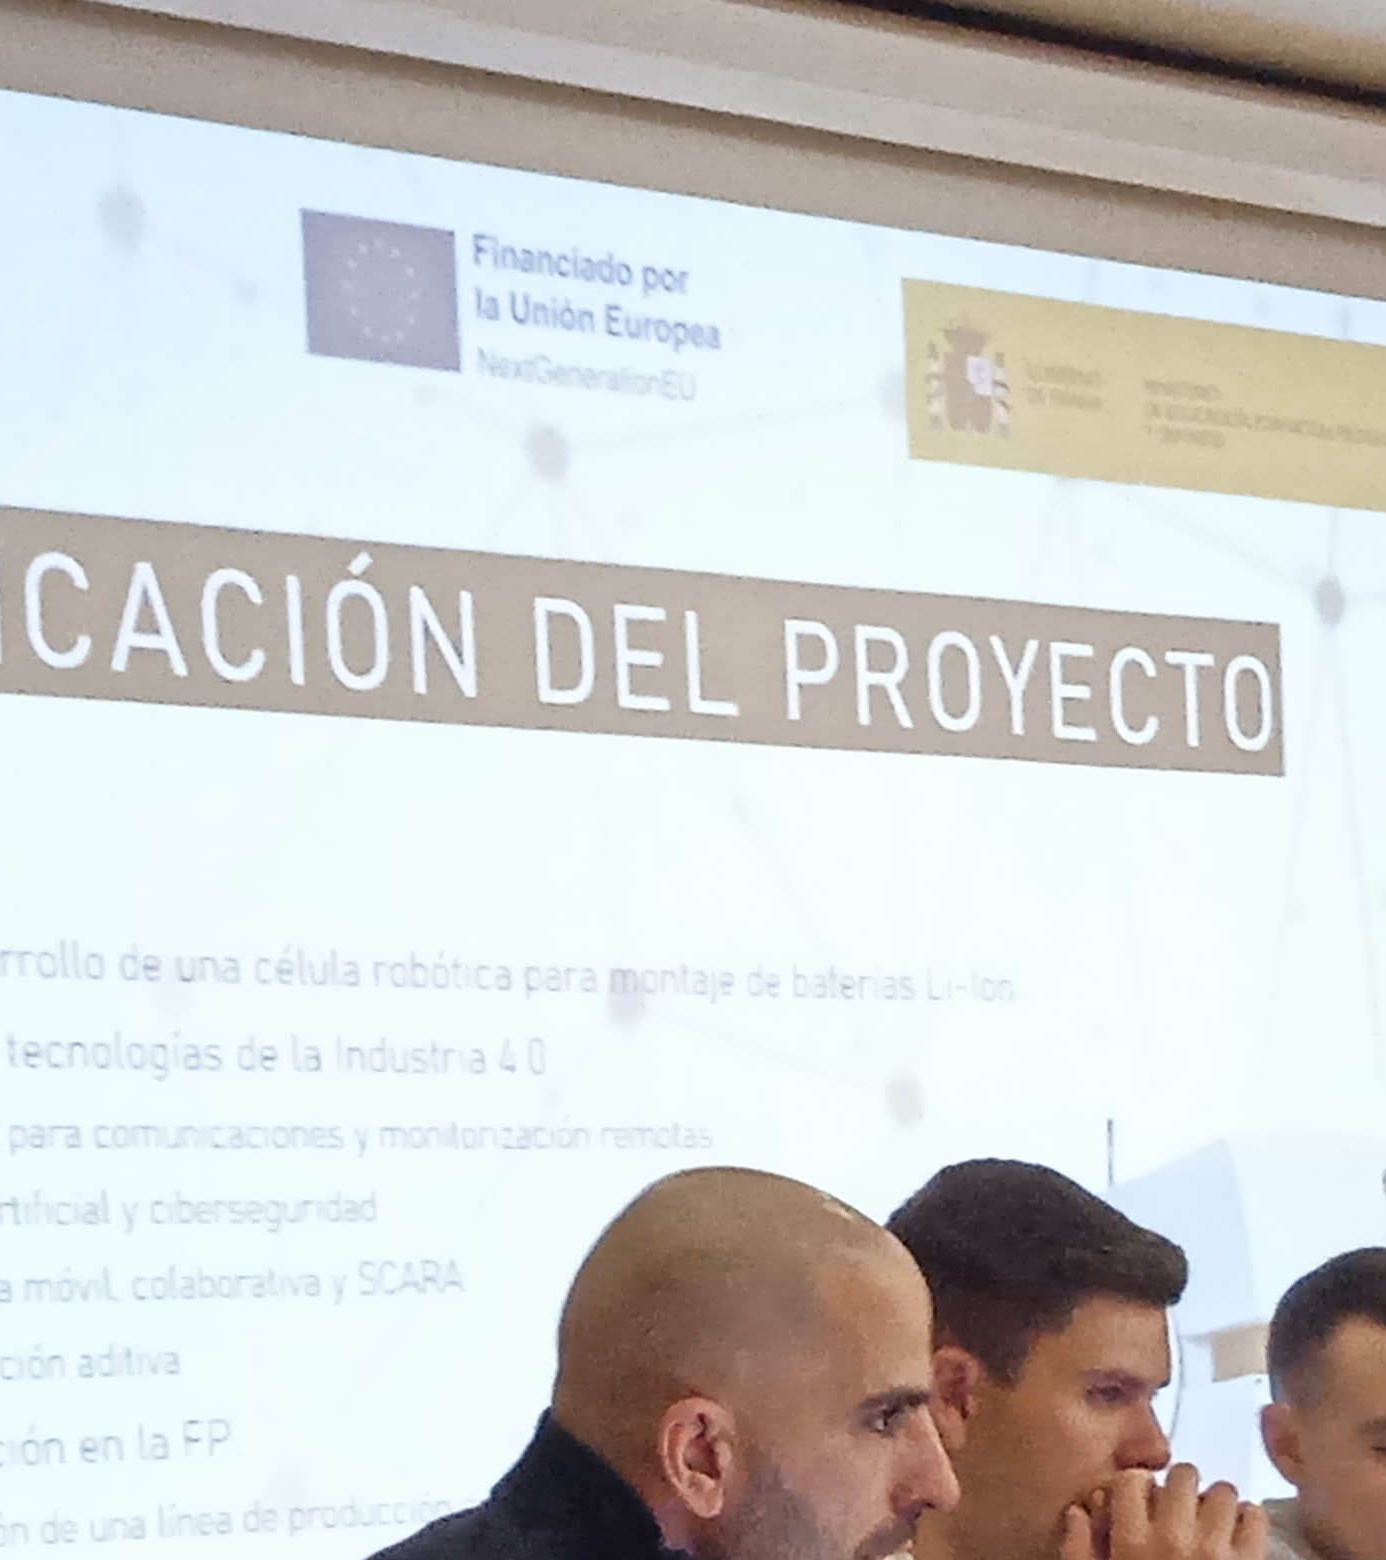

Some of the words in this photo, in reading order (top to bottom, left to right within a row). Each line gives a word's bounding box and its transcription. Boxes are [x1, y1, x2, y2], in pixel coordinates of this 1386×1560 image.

[472, 233, 633, 286] Financiado
[642, 265, 689, 299] por
[473, 286, 499, 321] la
[509, 289, 596, 334] Unión
[605, 303, 722, 354] Europea
[533, 596, 739, 717] DEL
[782, 618, 1273, 753] PROYECTO
[120, 945, 161, 983] de
[175, 954, 241, 986] una
[254, 944, 361, 988] célula
[373, 948, 513, 992] robótica
[524, 966, 600, 1000] para
[609, 961, 736, 1006] montaje
[747, 966, 780, 998] de
[6, 1028, 223, 1082] tecnologías
[238, 1036, 277, 1073] de
[291, 1036, 323, 1073] la
[337, 1036, 487, 1075] Industria
[9, 1123, 83, 1156] para
[94, 1117, 345, 1152] comunicaciones
[355, 1124, 369, 1158] y
[380, 1115, 590, 1150] monitorización
[600, 1121, 714, 1151] remotas
[121, 1197, 139, 1234] y
[150, 1189, 377, 1232] ciberseguridad
[132, 1265, 320, 1302] colaborativa
[333, 1274, 348, 1304] y
[358, 1259, 466, 1297] SCARA
[76, 1342, 181, 1379] aditiva
[79, 1430, 123, 1468] en
[138, 1423, 169, 1460] la
[183, 1418, 231, 1457] FP
[40, 1506, 78, 1547] de
[90, 1514, 146, 1543] una
[157, 1503, 233, 1538] línea
[242, 1498, 277, 1535] de
